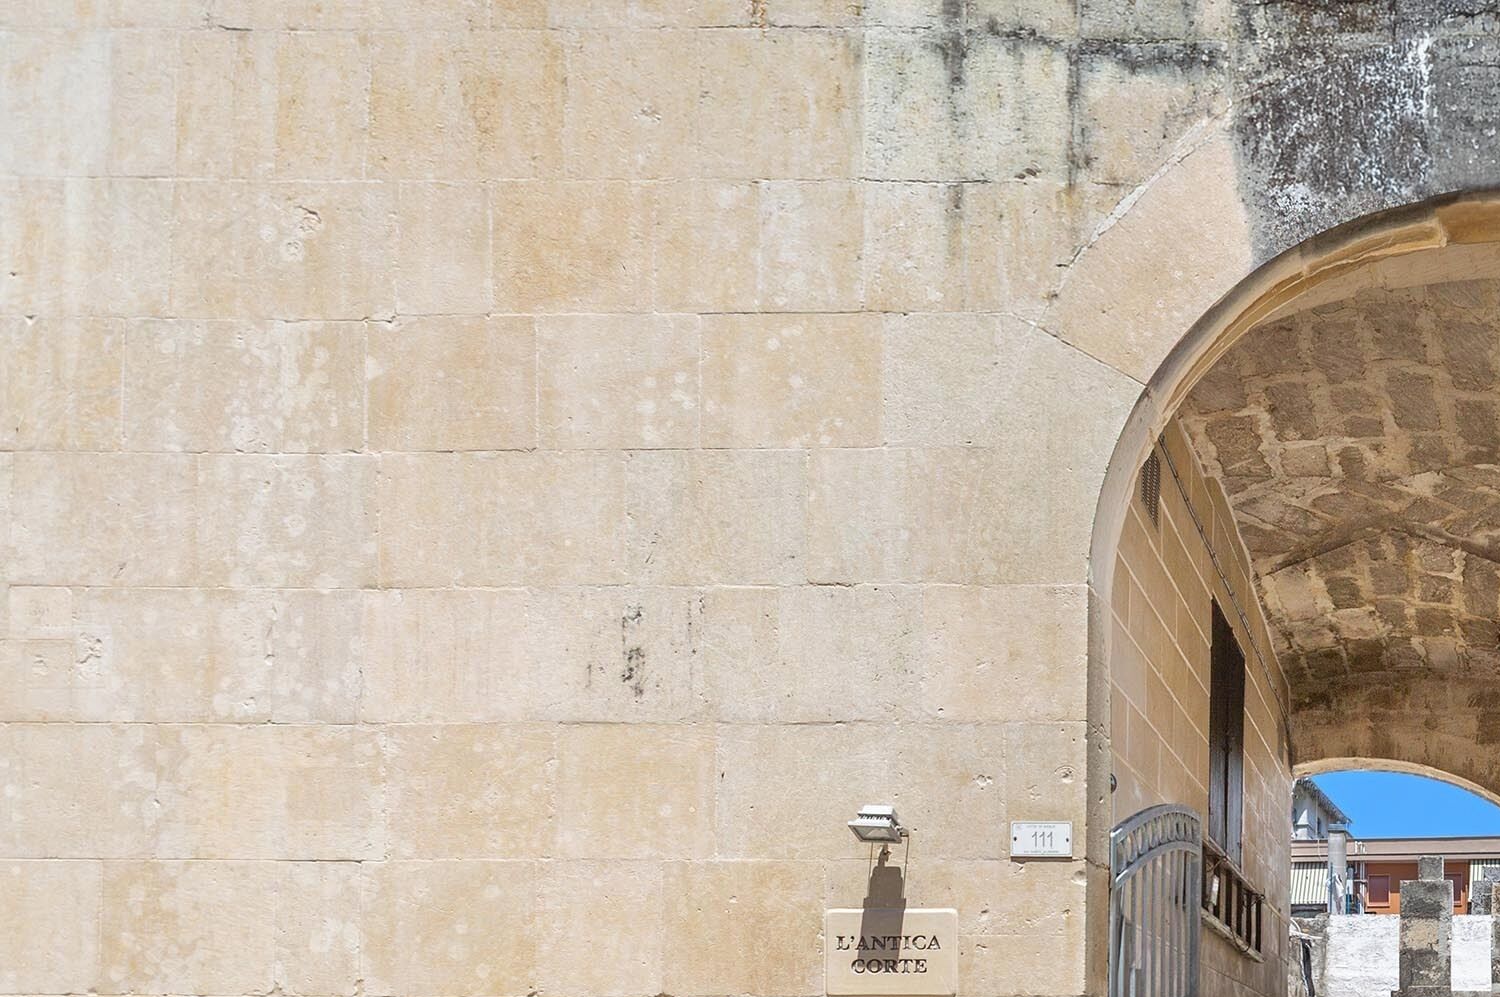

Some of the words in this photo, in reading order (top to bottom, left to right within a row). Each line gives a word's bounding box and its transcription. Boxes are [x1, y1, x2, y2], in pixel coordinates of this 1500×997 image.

[1031, 831, 1053, 849] 111
[836, 935, 941, 951] L'ANTICA
[851, 958, 927, 974] CORTE
